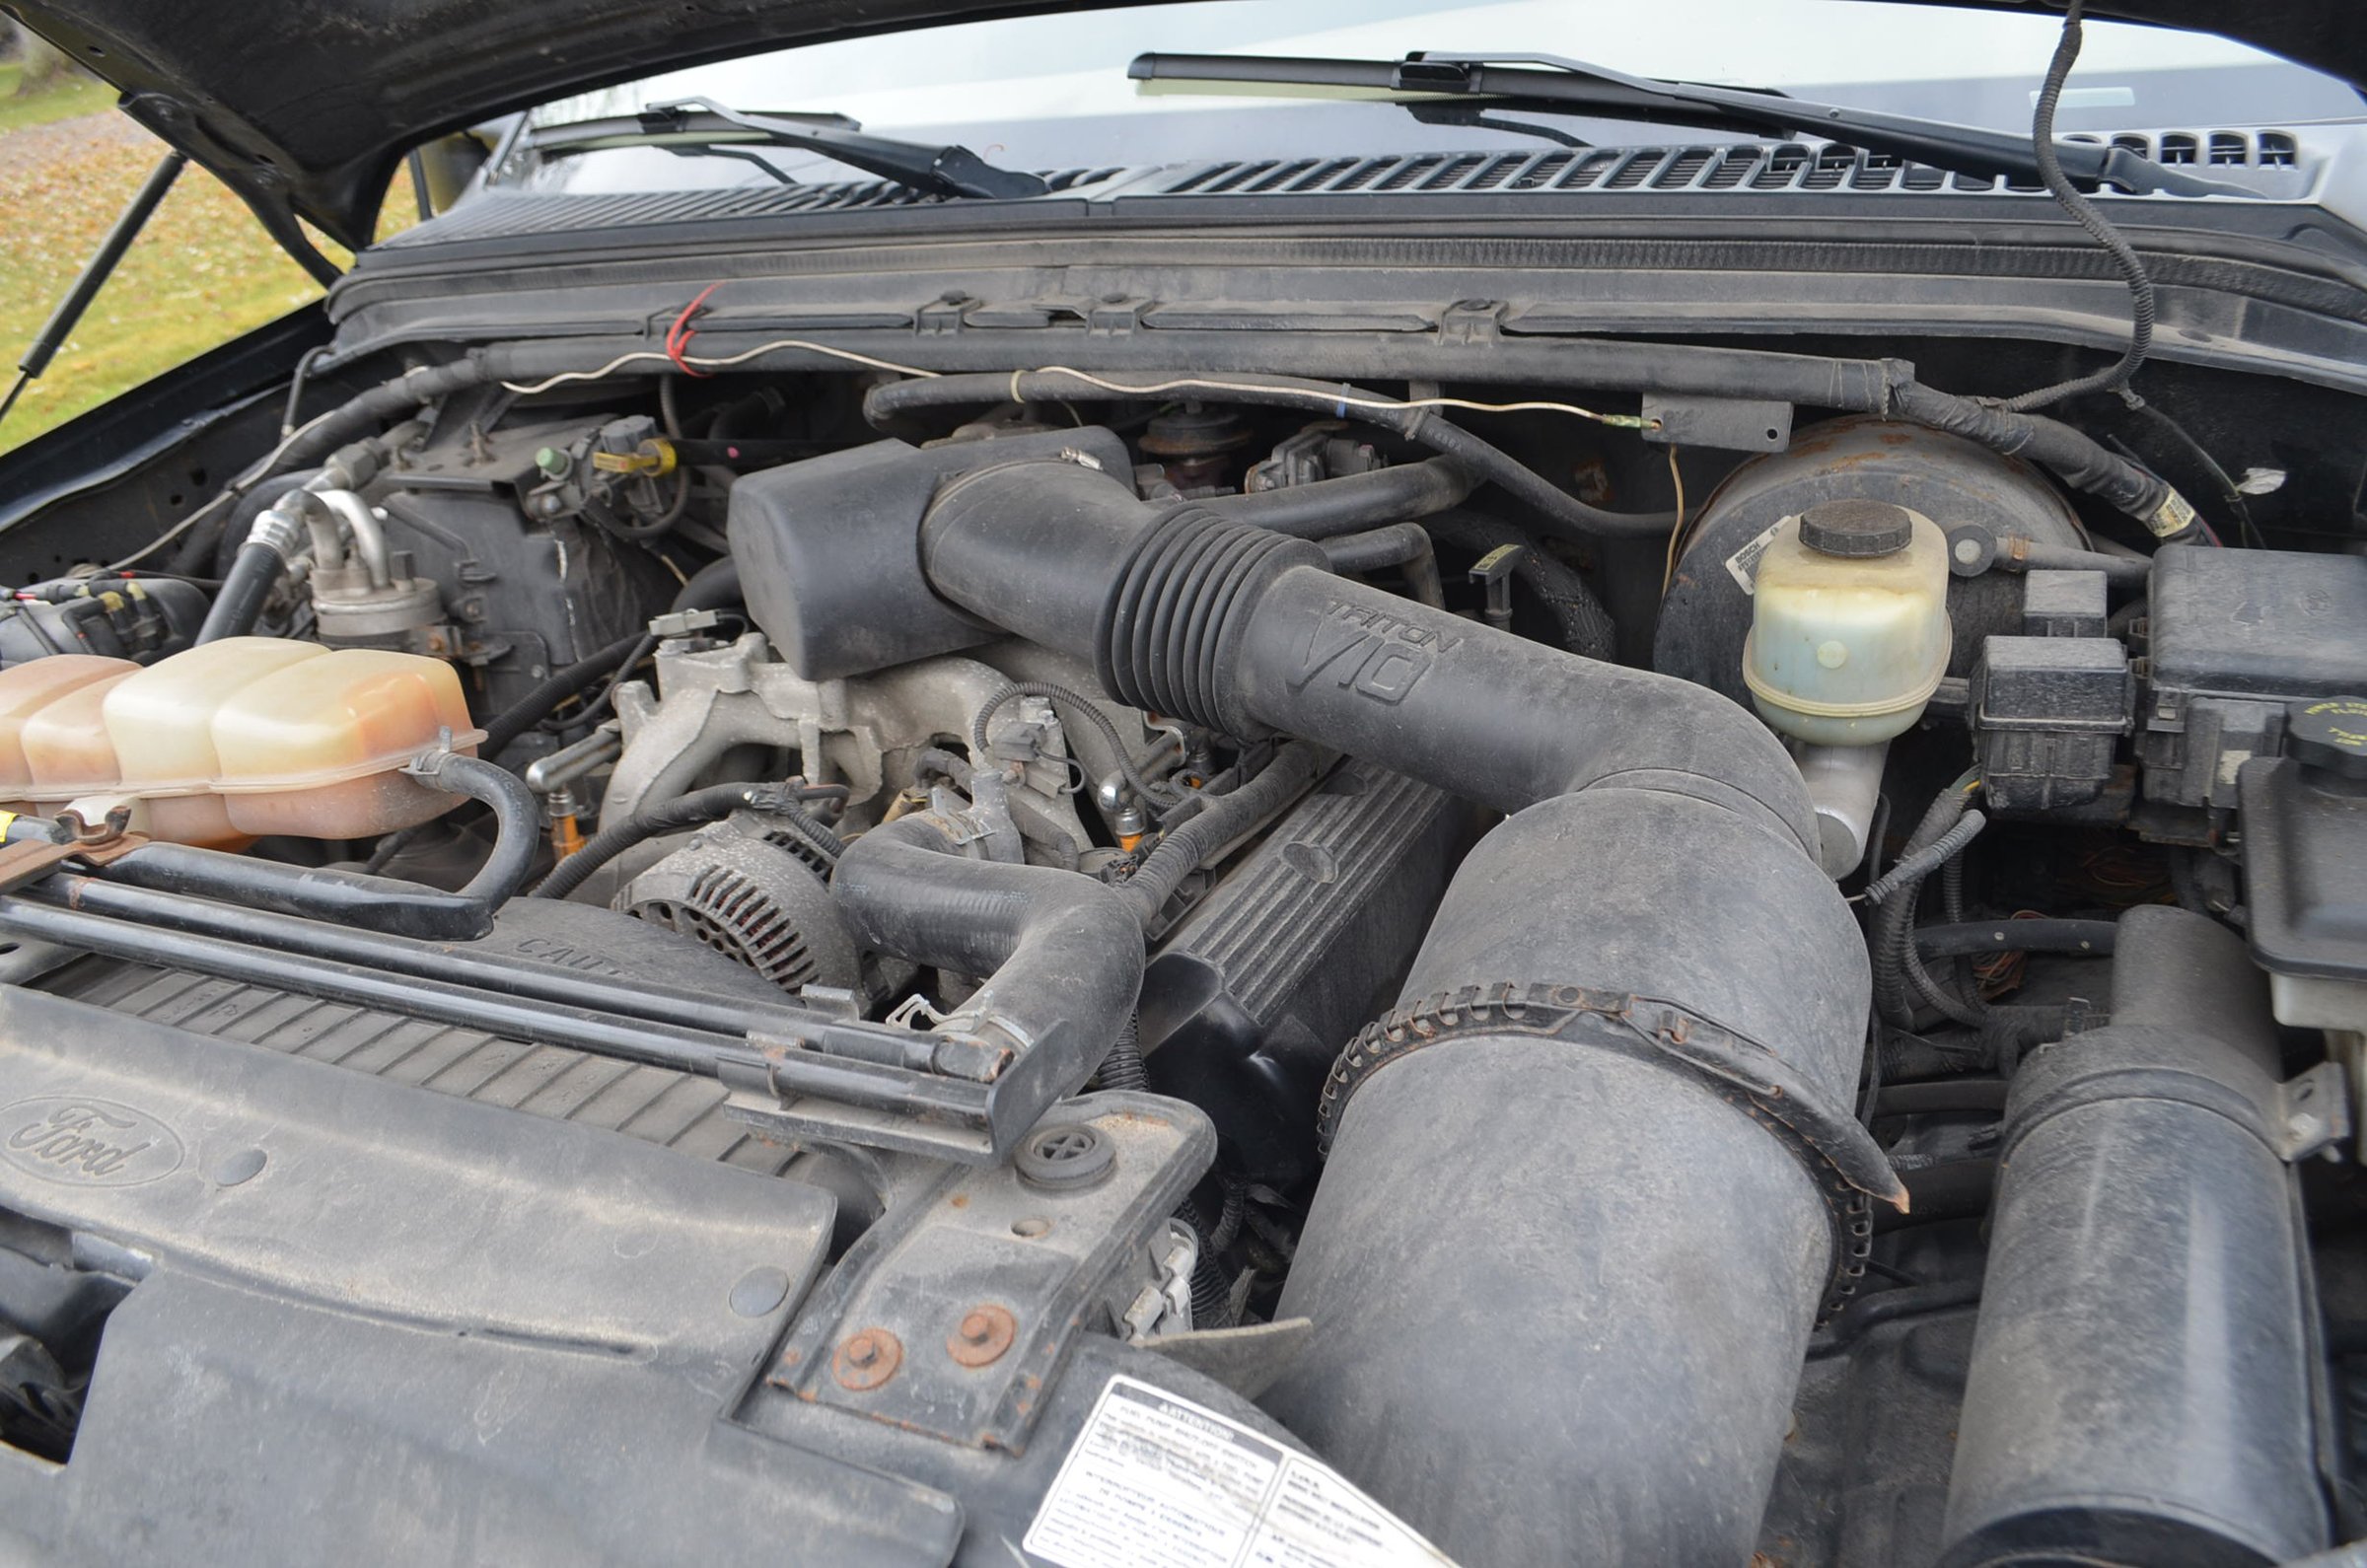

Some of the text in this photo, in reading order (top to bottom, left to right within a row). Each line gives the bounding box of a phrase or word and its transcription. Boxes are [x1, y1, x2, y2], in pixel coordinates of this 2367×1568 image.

[1735, 541, 1760, 564] BOSCH
[1327, 598, 1465, 654] TRITON
[1285, 630, 1433, 707] V10
[9, 1105, 151, 1176] Ford
